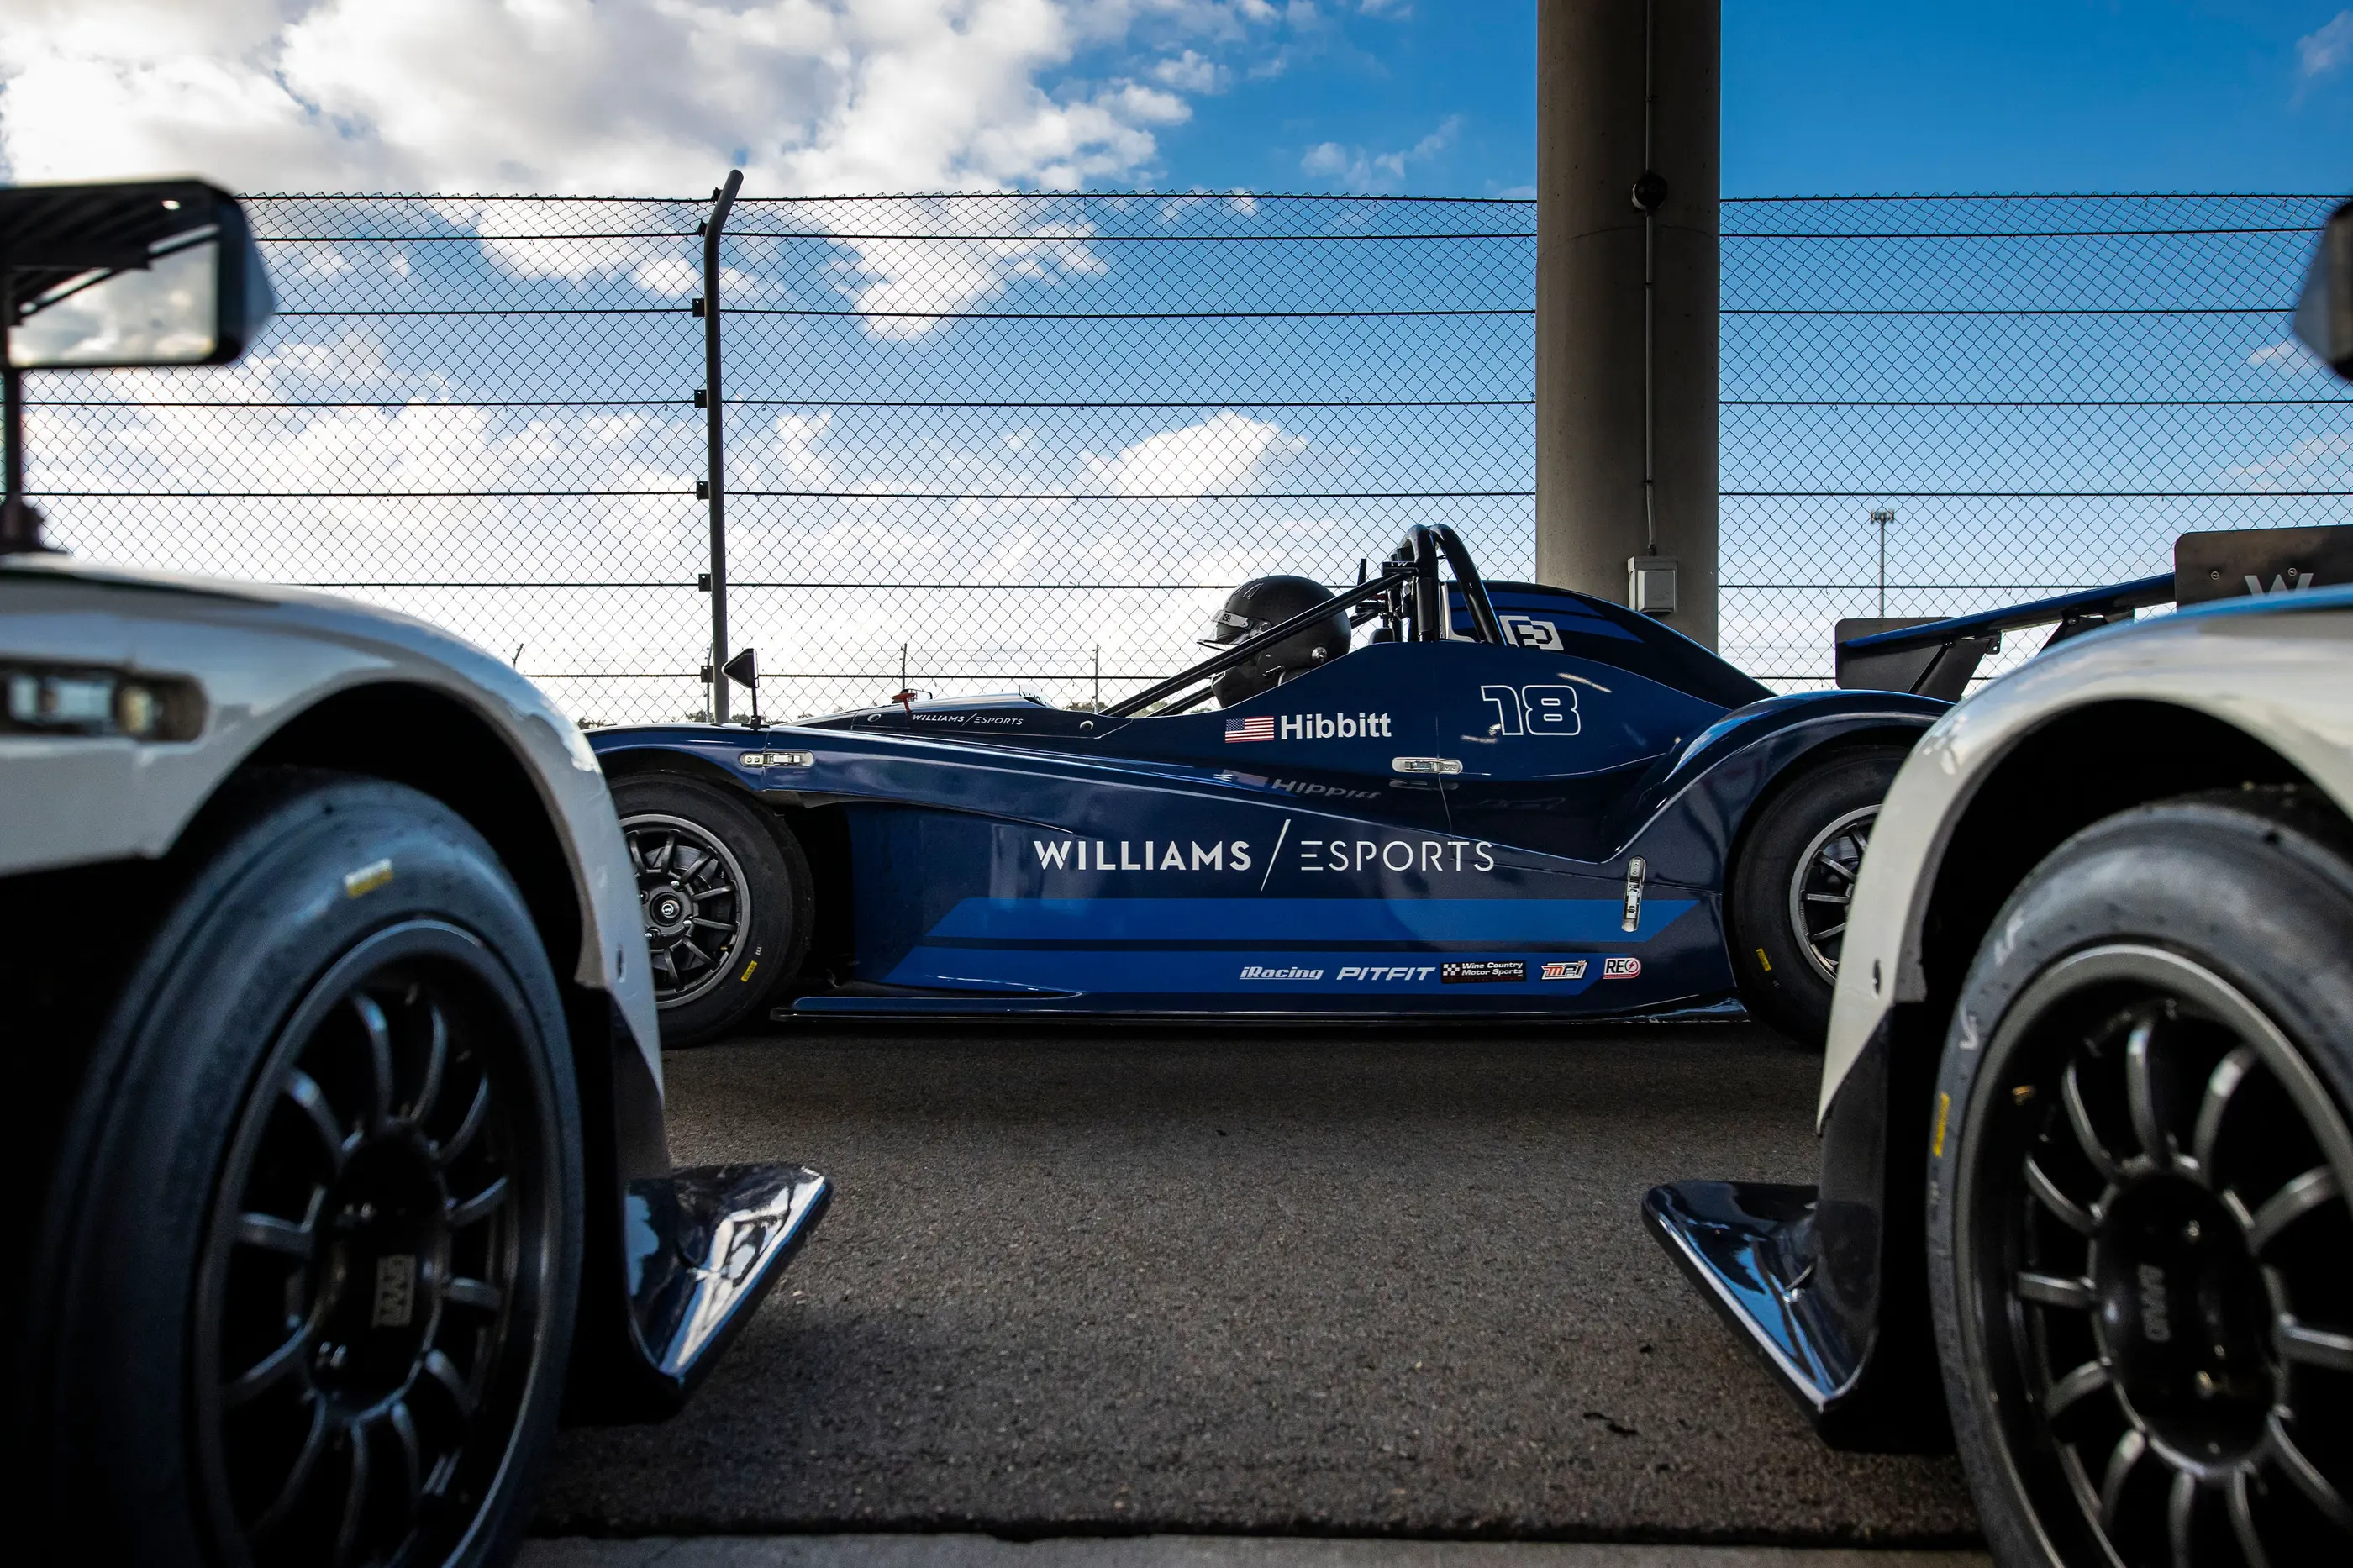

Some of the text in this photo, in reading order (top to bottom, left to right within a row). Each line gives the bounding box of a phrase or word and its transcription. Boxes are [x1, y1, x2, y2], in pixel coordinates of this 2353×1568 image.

[1481, 684, 1582, 736] 18
[912, 714, 965, 723] WILLIAMS
[973, 716, 1024, 725] ESPORTS
[1280, 712, 1392, 740] Hibbitt
[1034, 840, 1251, 871] WILLIAMS
[1300, 840, 1496, 872] ESPORTS
[1240, 966, 1324, 981] iRacing
[1336, 966, 1436, 981] PITFIT
[1492, 968, 1524, 976] Sports
